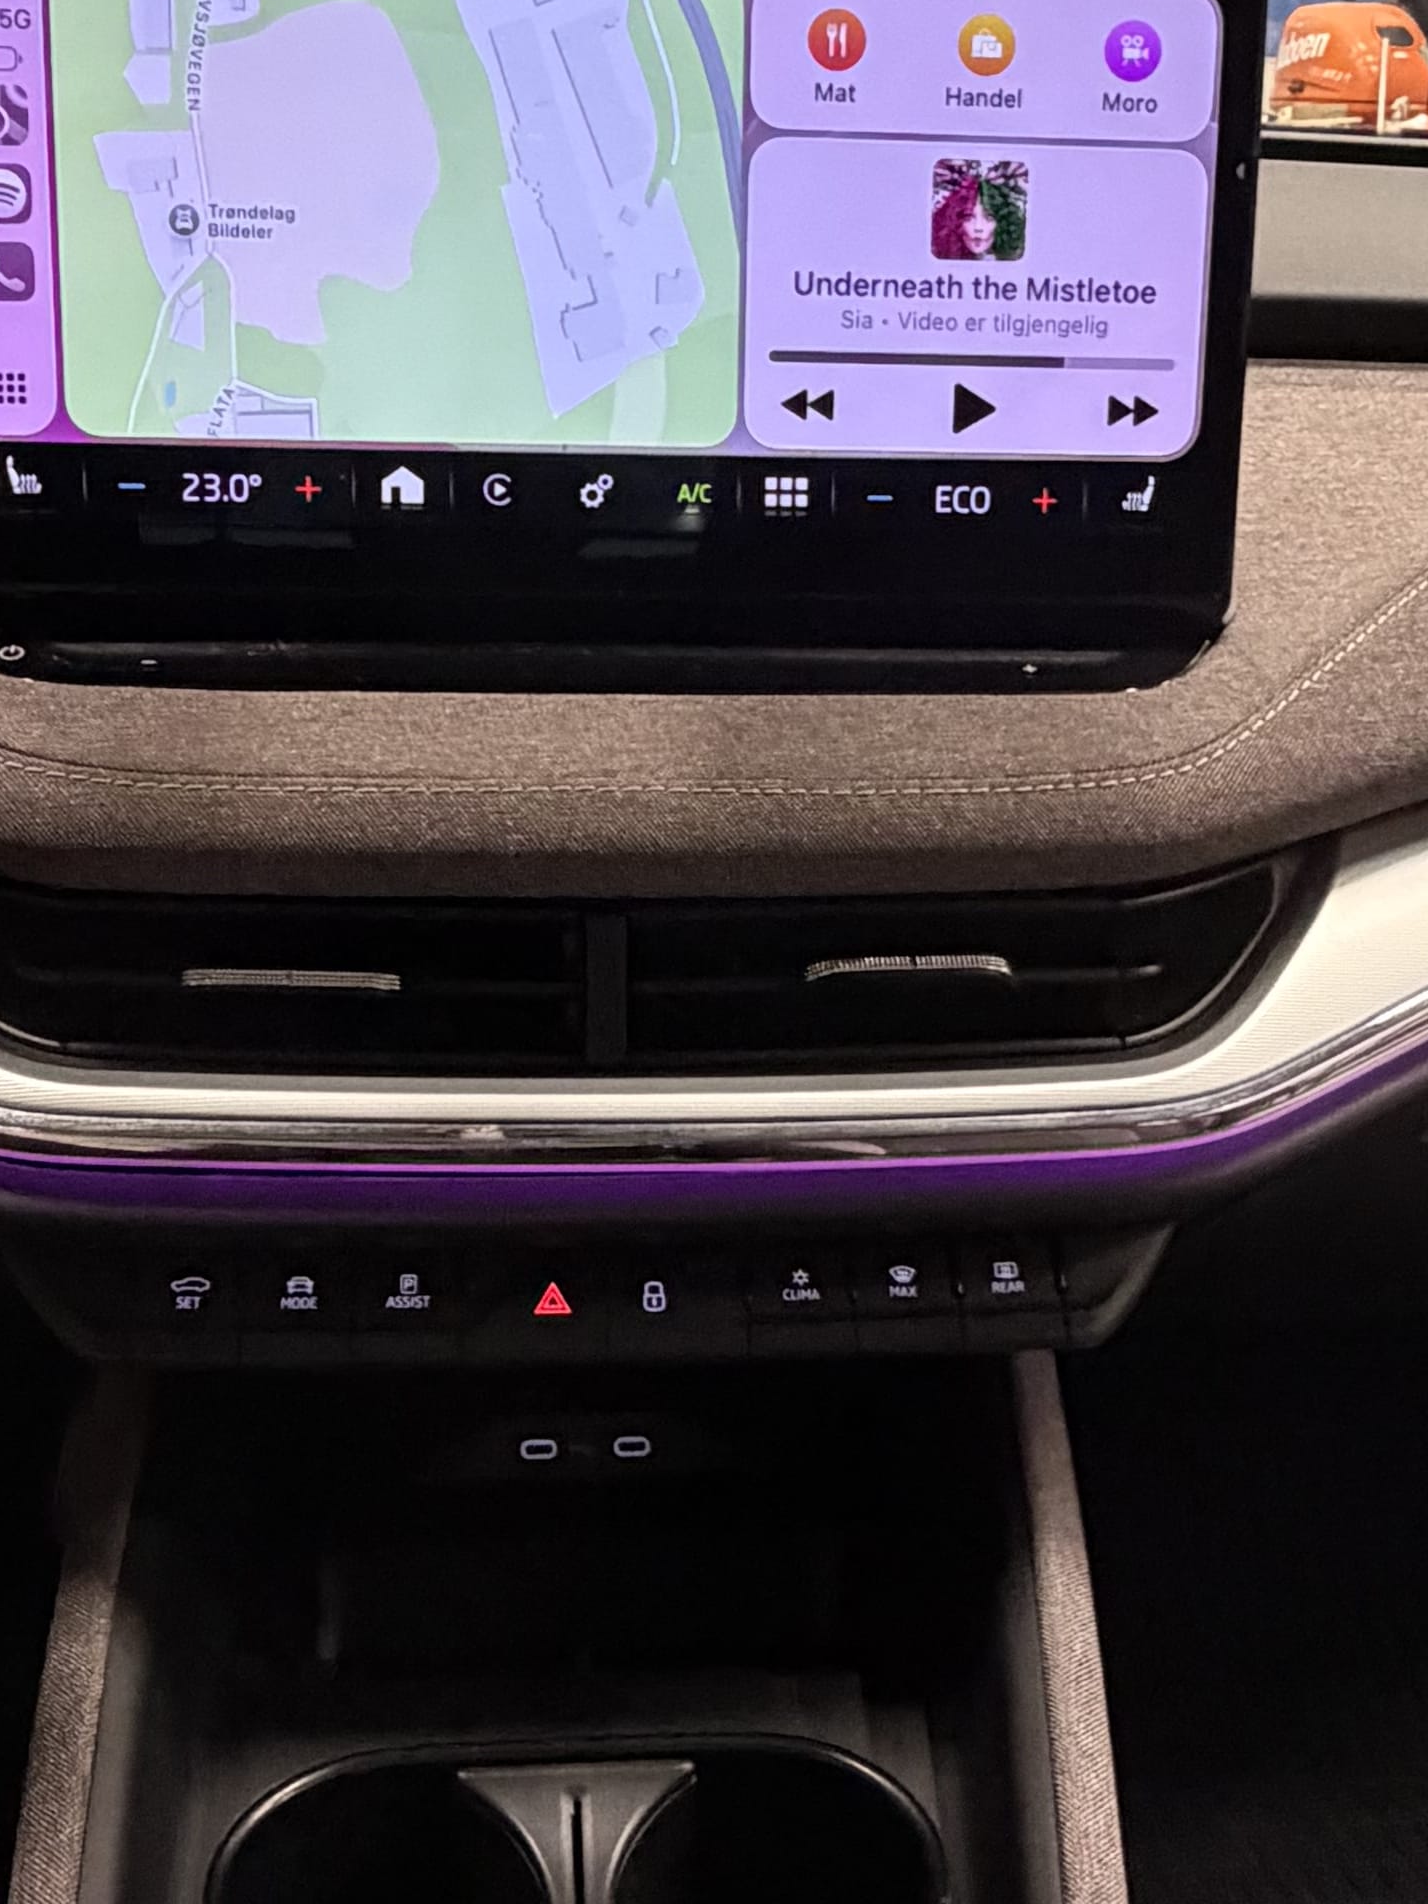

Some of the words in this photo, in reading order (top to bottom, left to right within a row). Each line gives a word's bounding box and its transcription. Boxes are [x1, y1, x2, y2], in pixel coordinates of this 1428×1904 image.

[0, 8, 31, 29] 5G
[814, 82, 857, 103] Mat
[945, 87, 1023, 109] Handel
[1102, 92, 1158, 113] Moro
[208, 203, 296, 225] Trøndelag
[208, 222, 273, 239] Bildeler
[793, 270, 963, 299] Underneath
[972, 275, 1018, 301] the
[1027, 277, 1157, 305] Mistletoe
[840, 309, 874, 330] Sia
[898, 310, 959, 332] Video
[965, 317, 986, 332] er
[993, 313, 1109, 339] tilgjengelig
[678, 482, 713, 505] A/C
[935, 485, 991, 514] ECO
[782, 1287, 821, 1301] CLIMA
[888, 1285, 918, 1298] MAX
[991, 1280, 1026, 1294] REAR
[175, 1295, 202, 1310] SET
[279, 1295, 318, 1310] MODE
[385, 1295, 431, 1309] ASSIST
